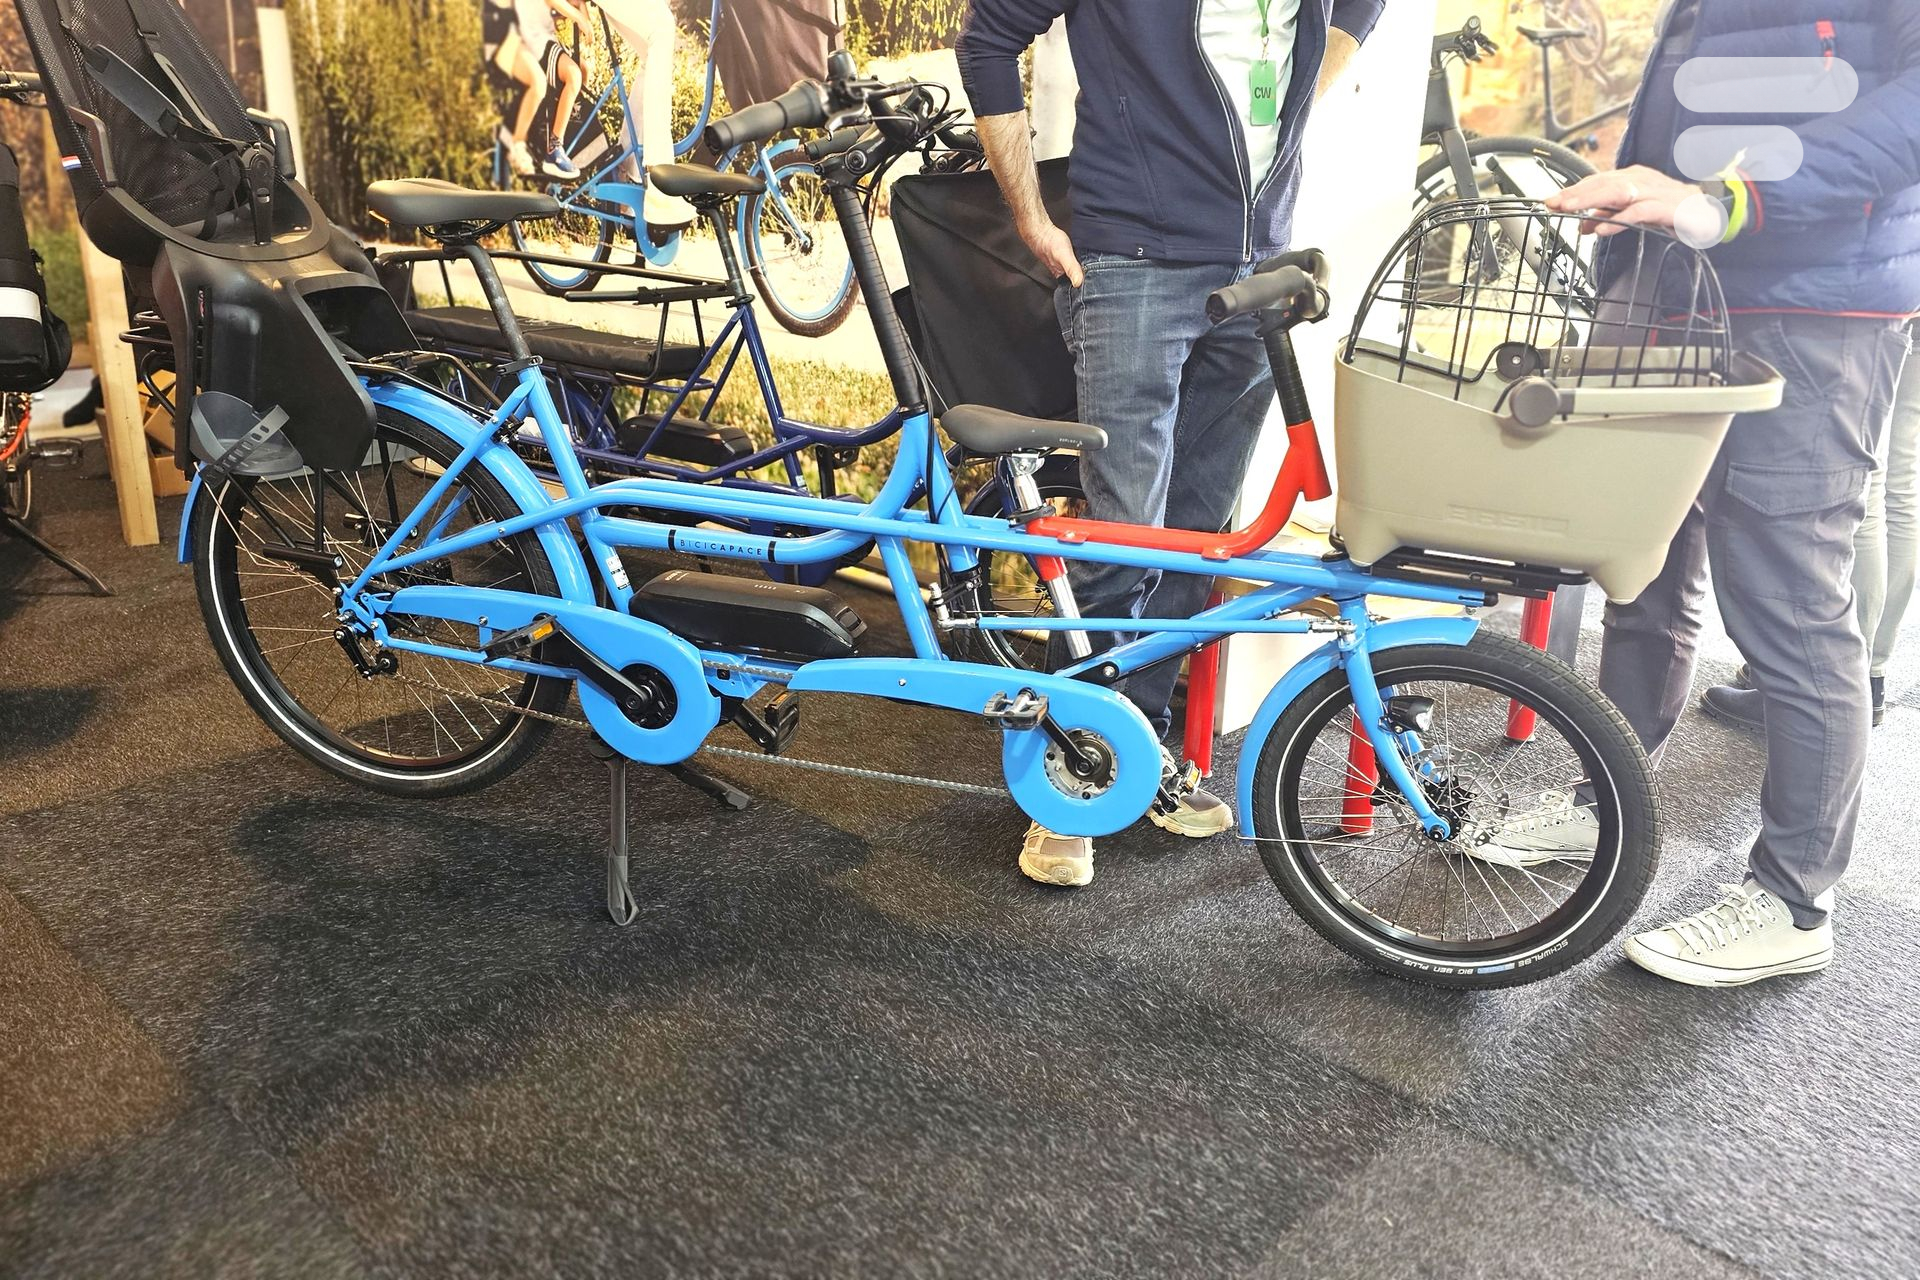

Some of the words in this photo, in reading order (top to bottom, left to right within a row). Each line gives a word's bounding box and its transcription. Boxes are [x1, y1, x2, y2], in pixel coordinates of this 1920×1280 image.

[1254, 86, 1272, 99] CW
[680, 539, 762, 556] BICICAPACE
[1517, 938, 1569, 968] SCHWALBE
[1402, 958, 1430, 971] PLUS
[1456, 967, 1474, 975] BIG
